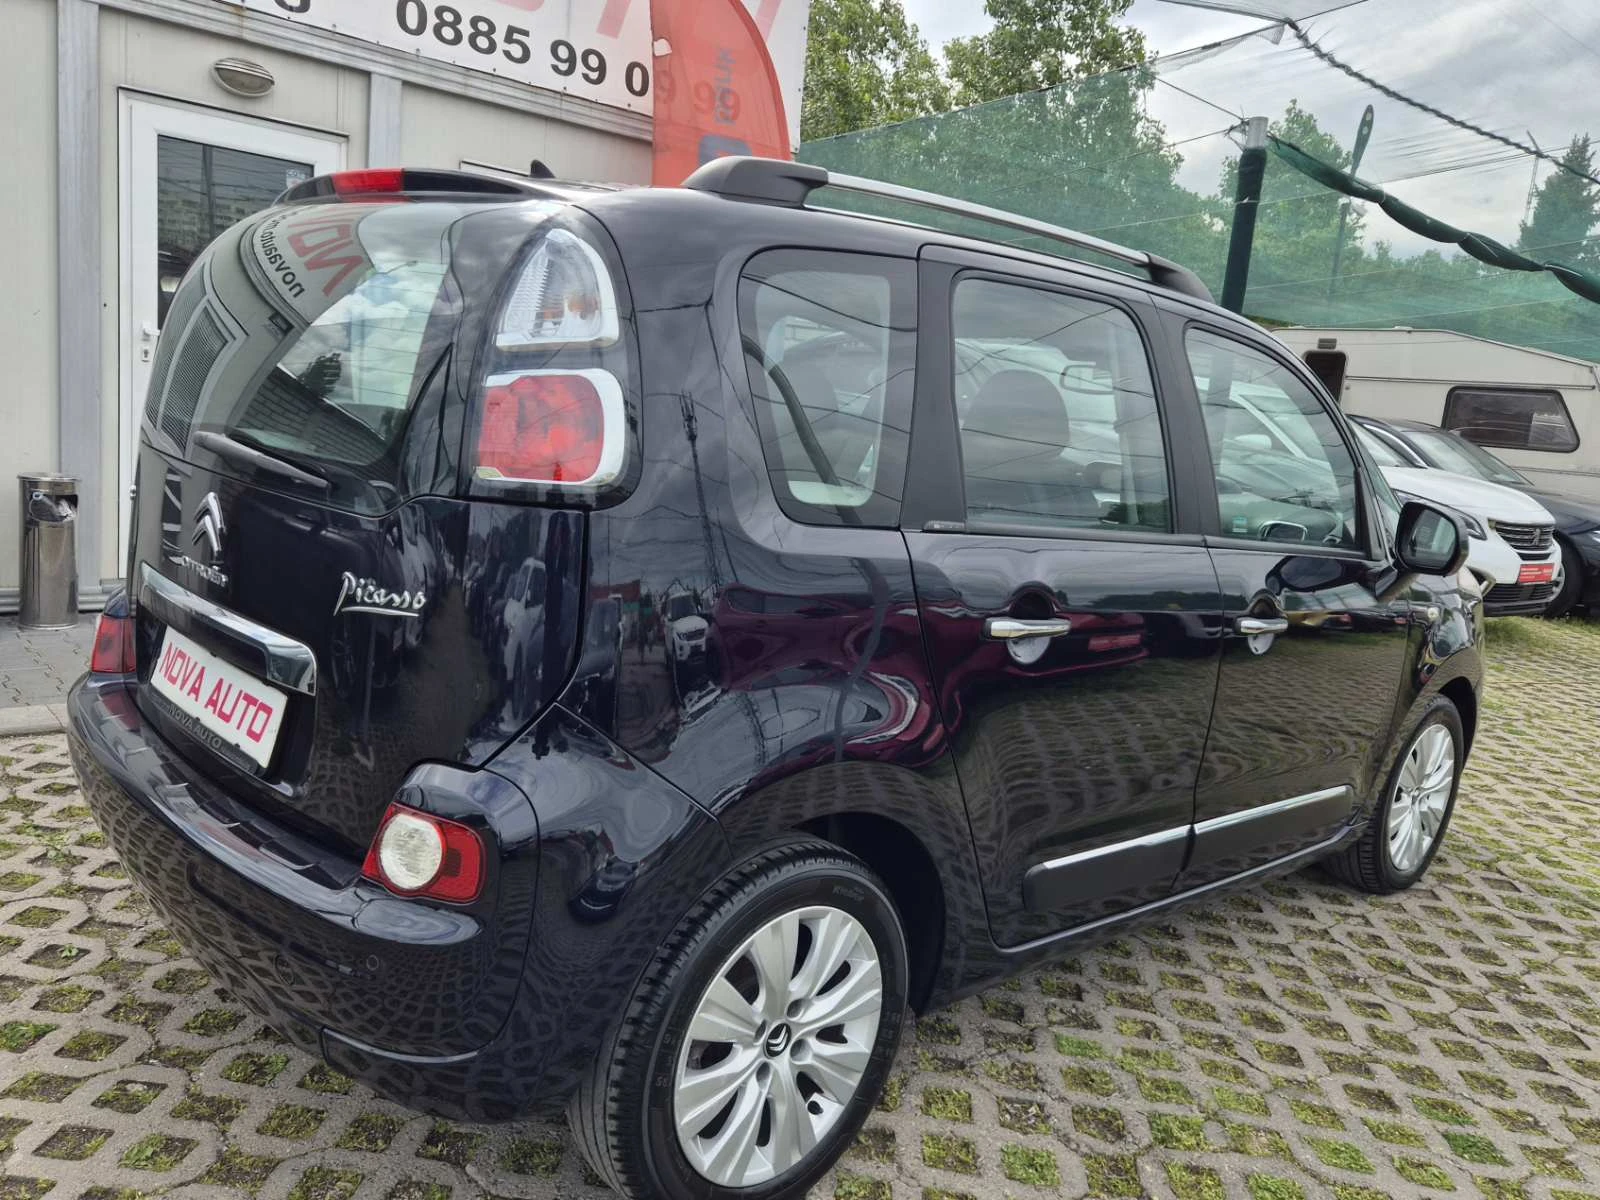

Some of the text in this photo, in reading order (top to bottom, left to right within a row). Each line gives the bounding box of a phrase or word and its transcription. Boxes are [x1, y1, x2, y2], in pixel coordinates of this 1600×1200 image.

[397, 0, 531, 64] 0885
[550, 39, 607, 85] 99
[333, 571, 427, 615] Picasso
[159, 643, 273, 743] NOVA AUTO
[168, 703, 223, 750] NOVA AUTO
